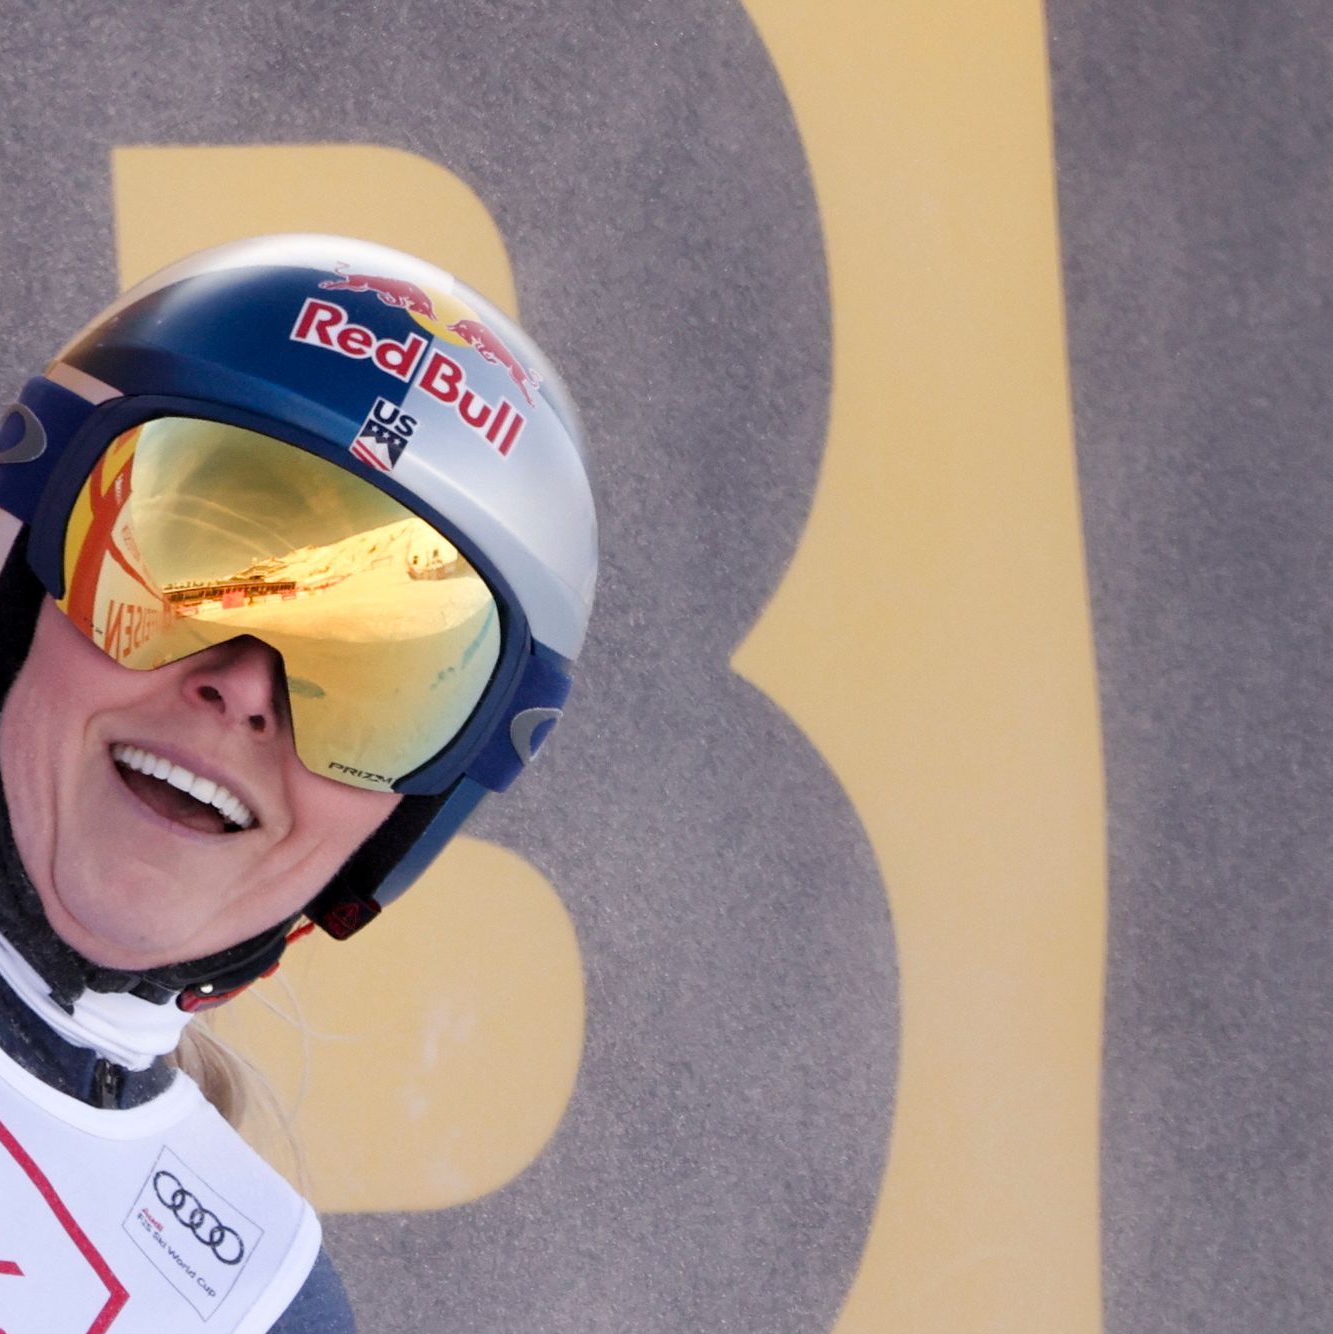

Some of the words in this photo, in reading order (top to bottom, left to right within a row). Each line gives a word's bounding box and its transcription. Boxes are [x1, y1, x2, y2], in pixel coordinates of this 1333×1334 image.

[291, 298, 428, 382] Red
[418, 350, 525, 457] Bull
[373, 399, 418, 438] US
[328, 761, 393, 784] PRIZM
[168, 1245, 197, 1279] World
[196, 1276, 217, 1297] Cup
